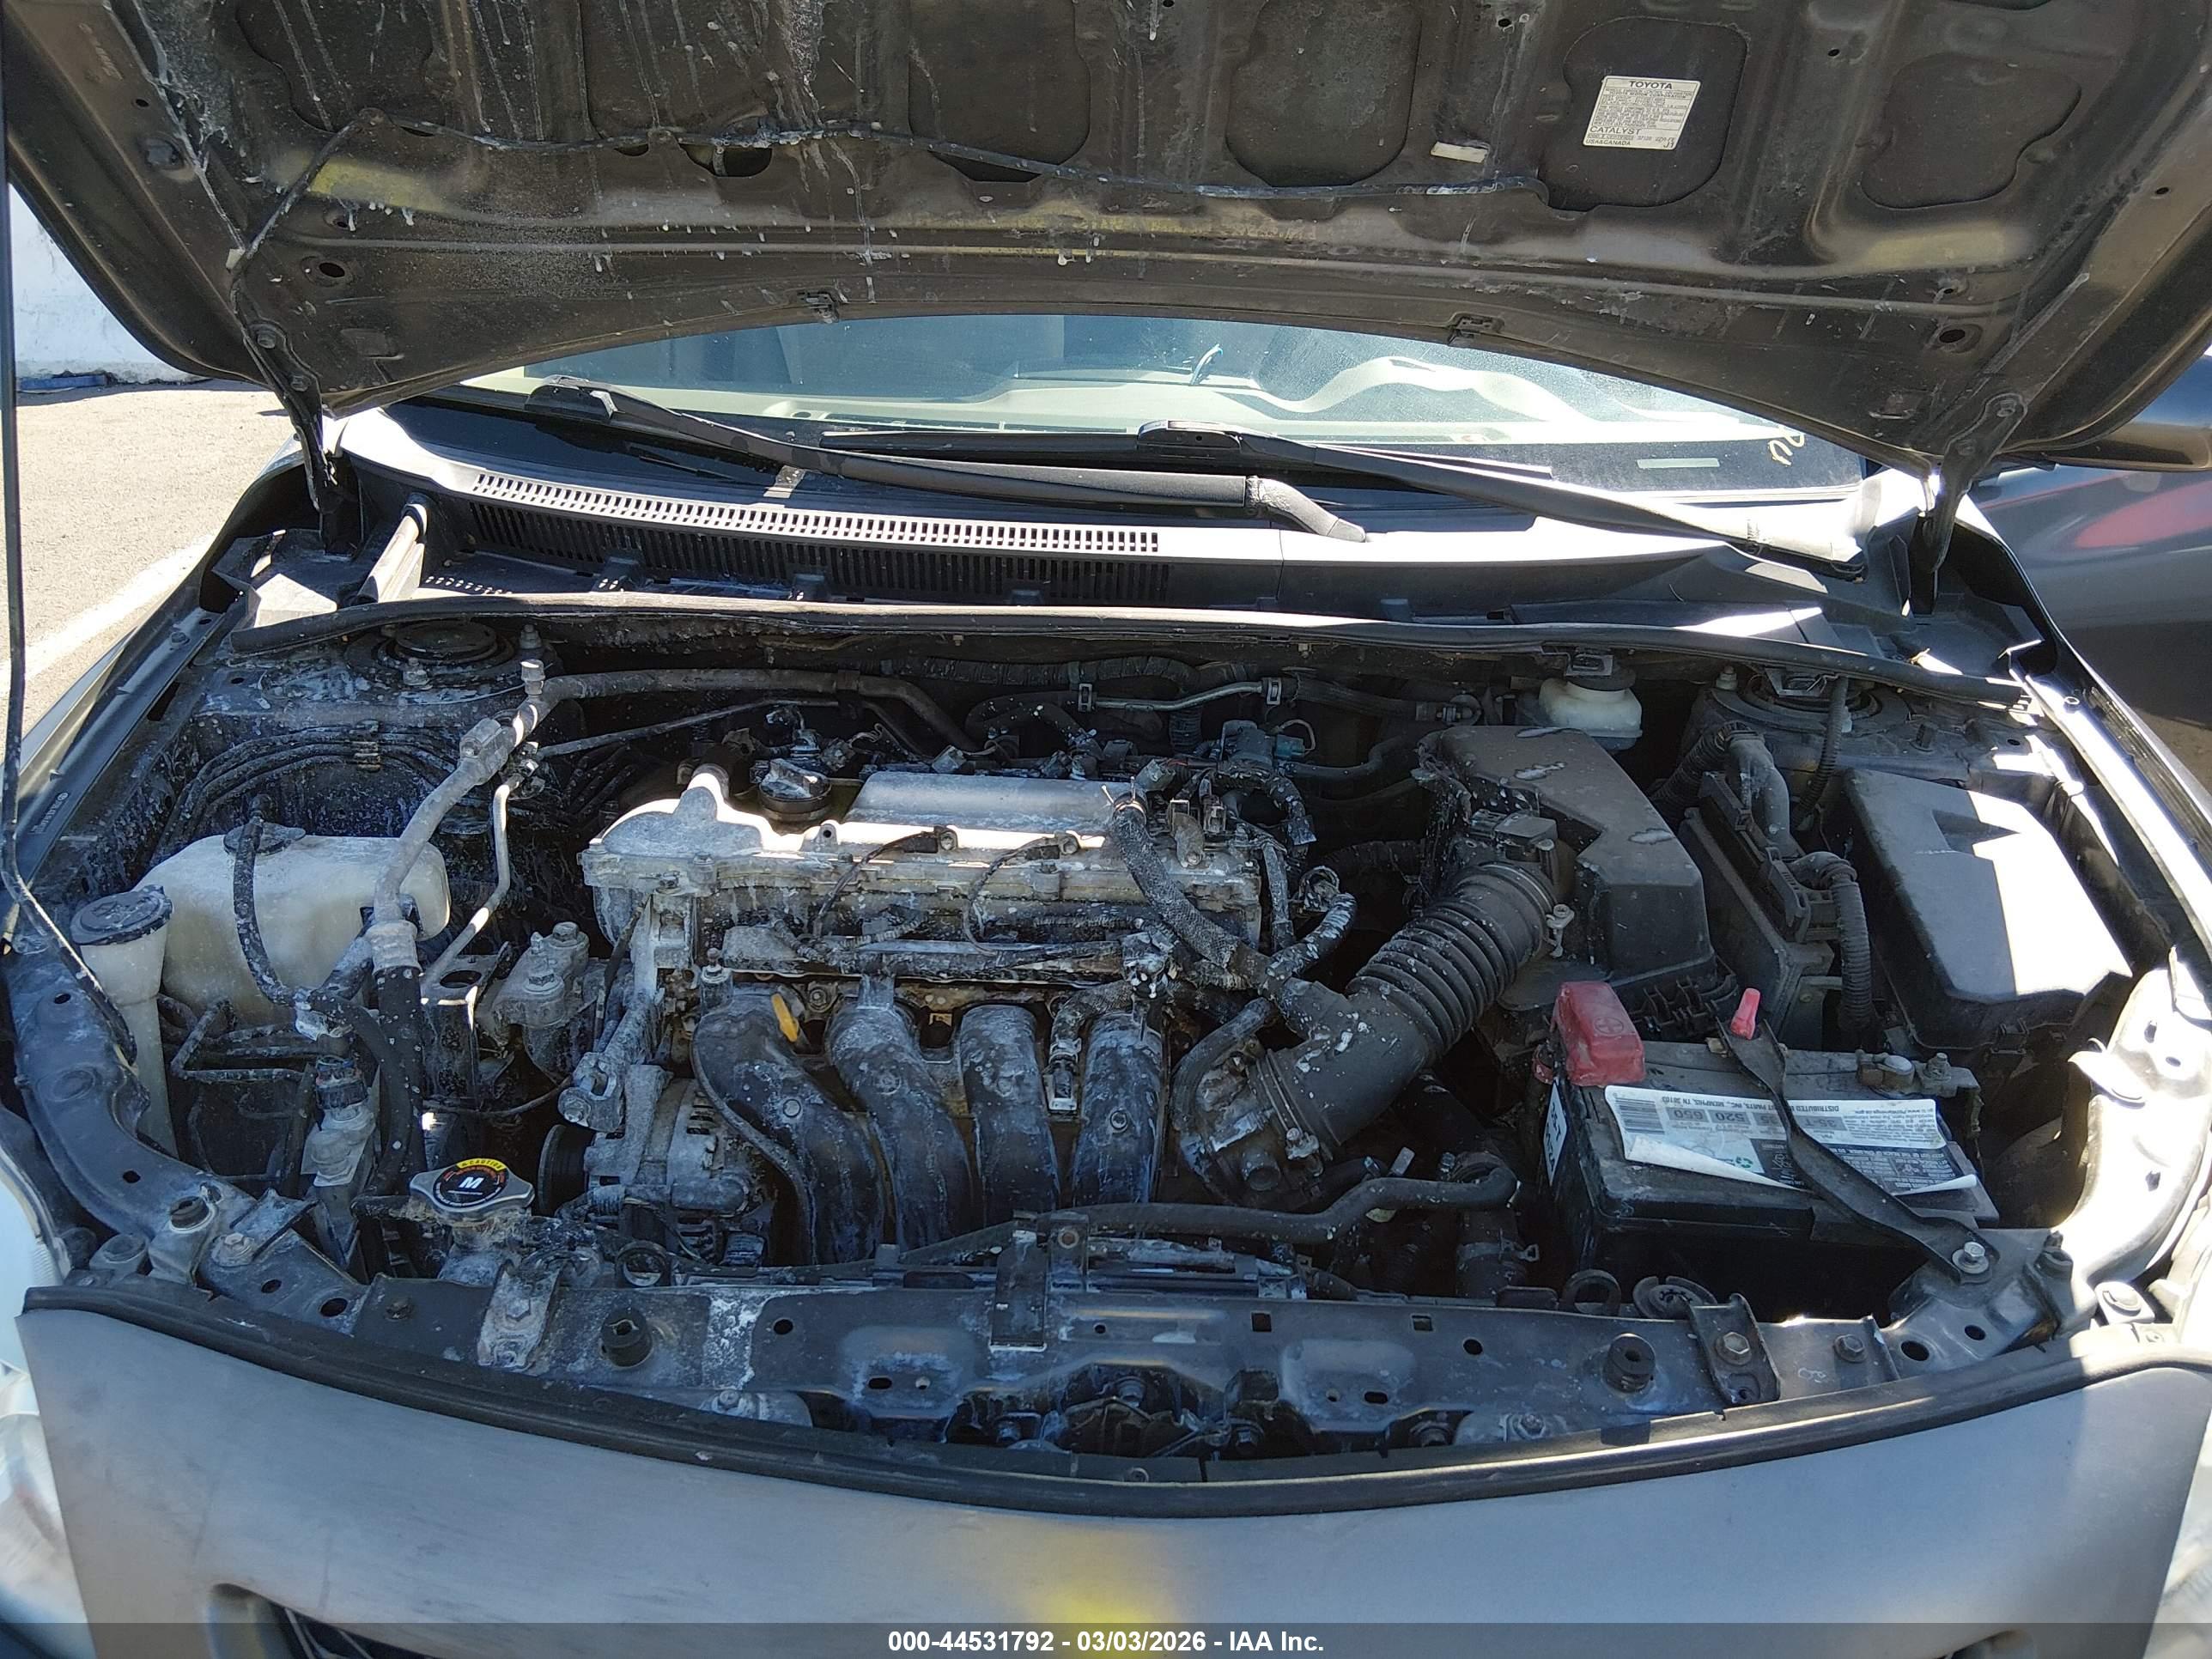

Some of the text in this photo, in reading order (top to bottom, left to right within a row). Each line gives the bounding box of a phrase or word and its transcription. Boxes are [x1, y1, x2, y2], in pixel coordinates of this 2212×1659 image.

[1629, 81, 1673, 90] TOYOTA
[1589, 126, 1642, 135] CATALYST
[1692, 1099, 1725, 1108] MEMPHIS,
[1674, 1110, 1703, 1119] 650
[1716, 1112, 1745, 1121] 520
[1805, 1119, 1836, 1127] 35-T
[459, 1176, 484, 1189] M
